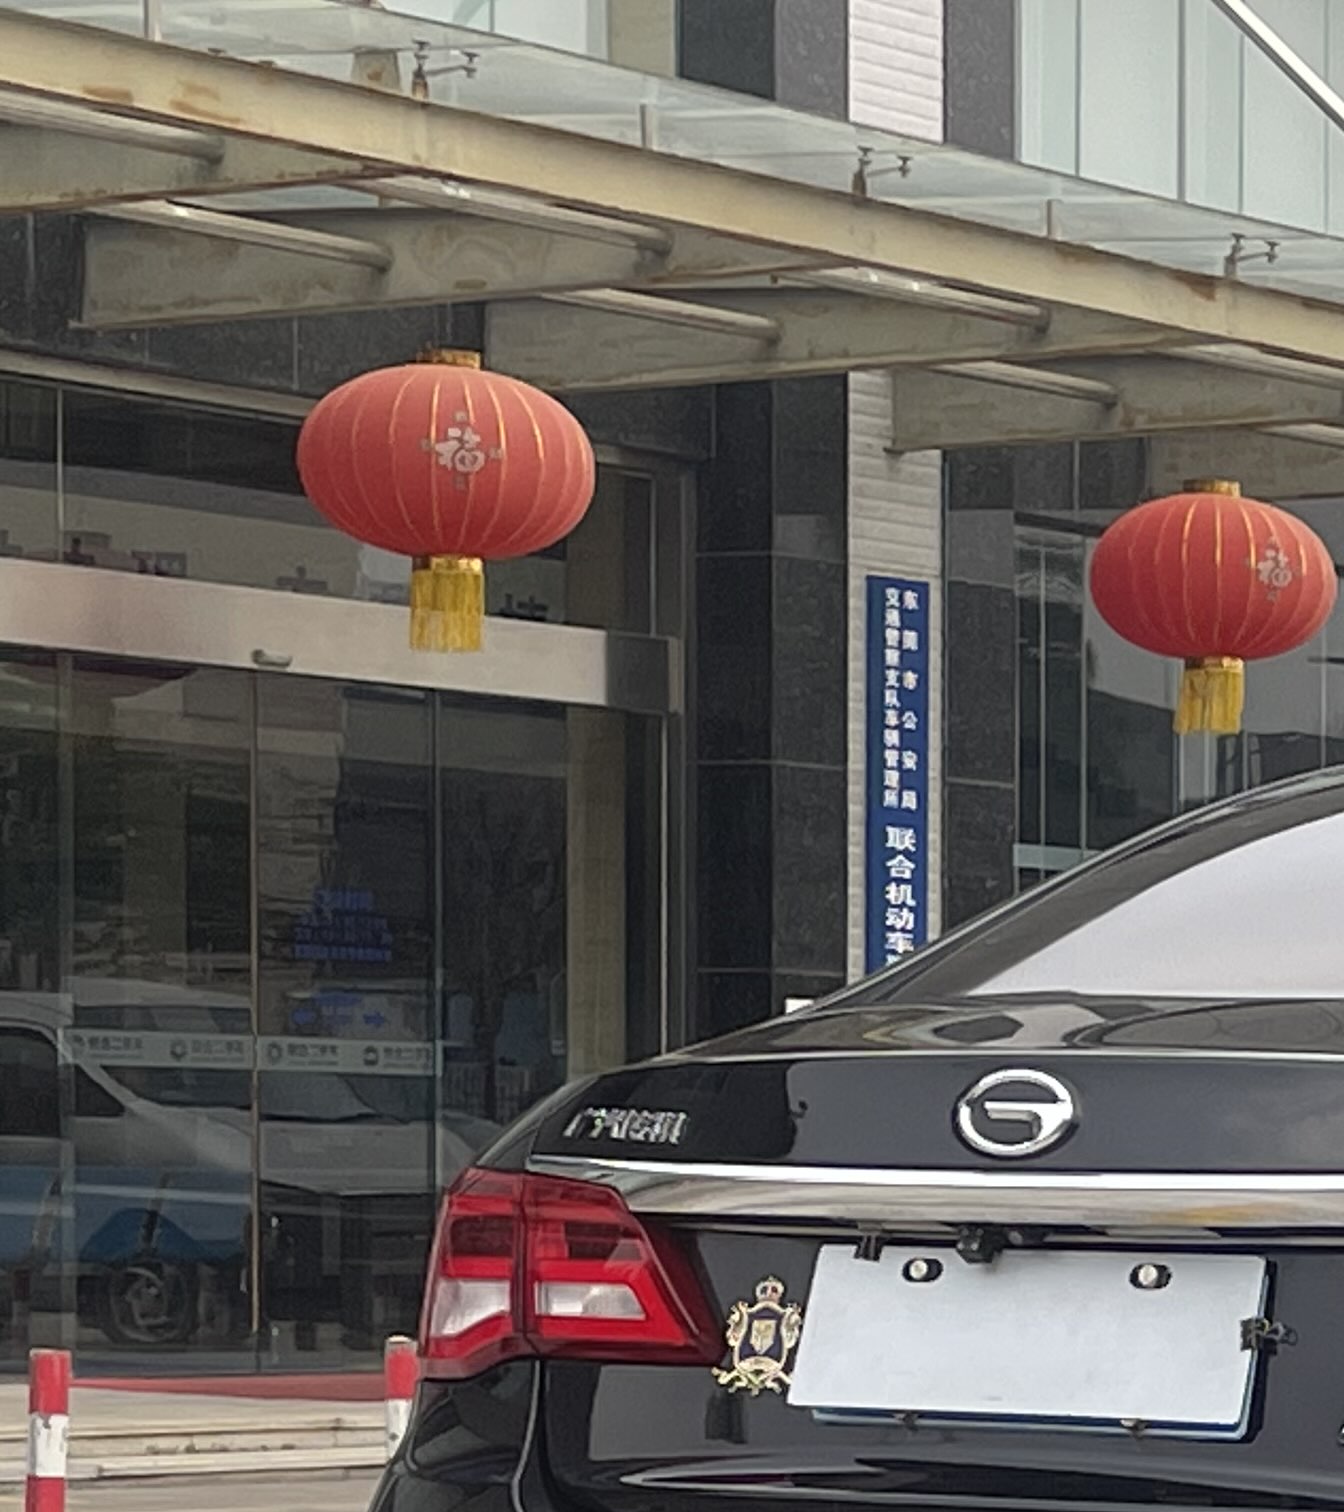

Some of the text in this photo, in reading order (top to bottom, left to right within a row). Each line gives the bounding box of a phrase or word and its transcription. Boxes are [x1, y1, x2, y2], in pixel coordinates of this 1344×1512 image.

[435, 427, 485, 473] 福
[884, 825, 917, 966] 联合机动车
